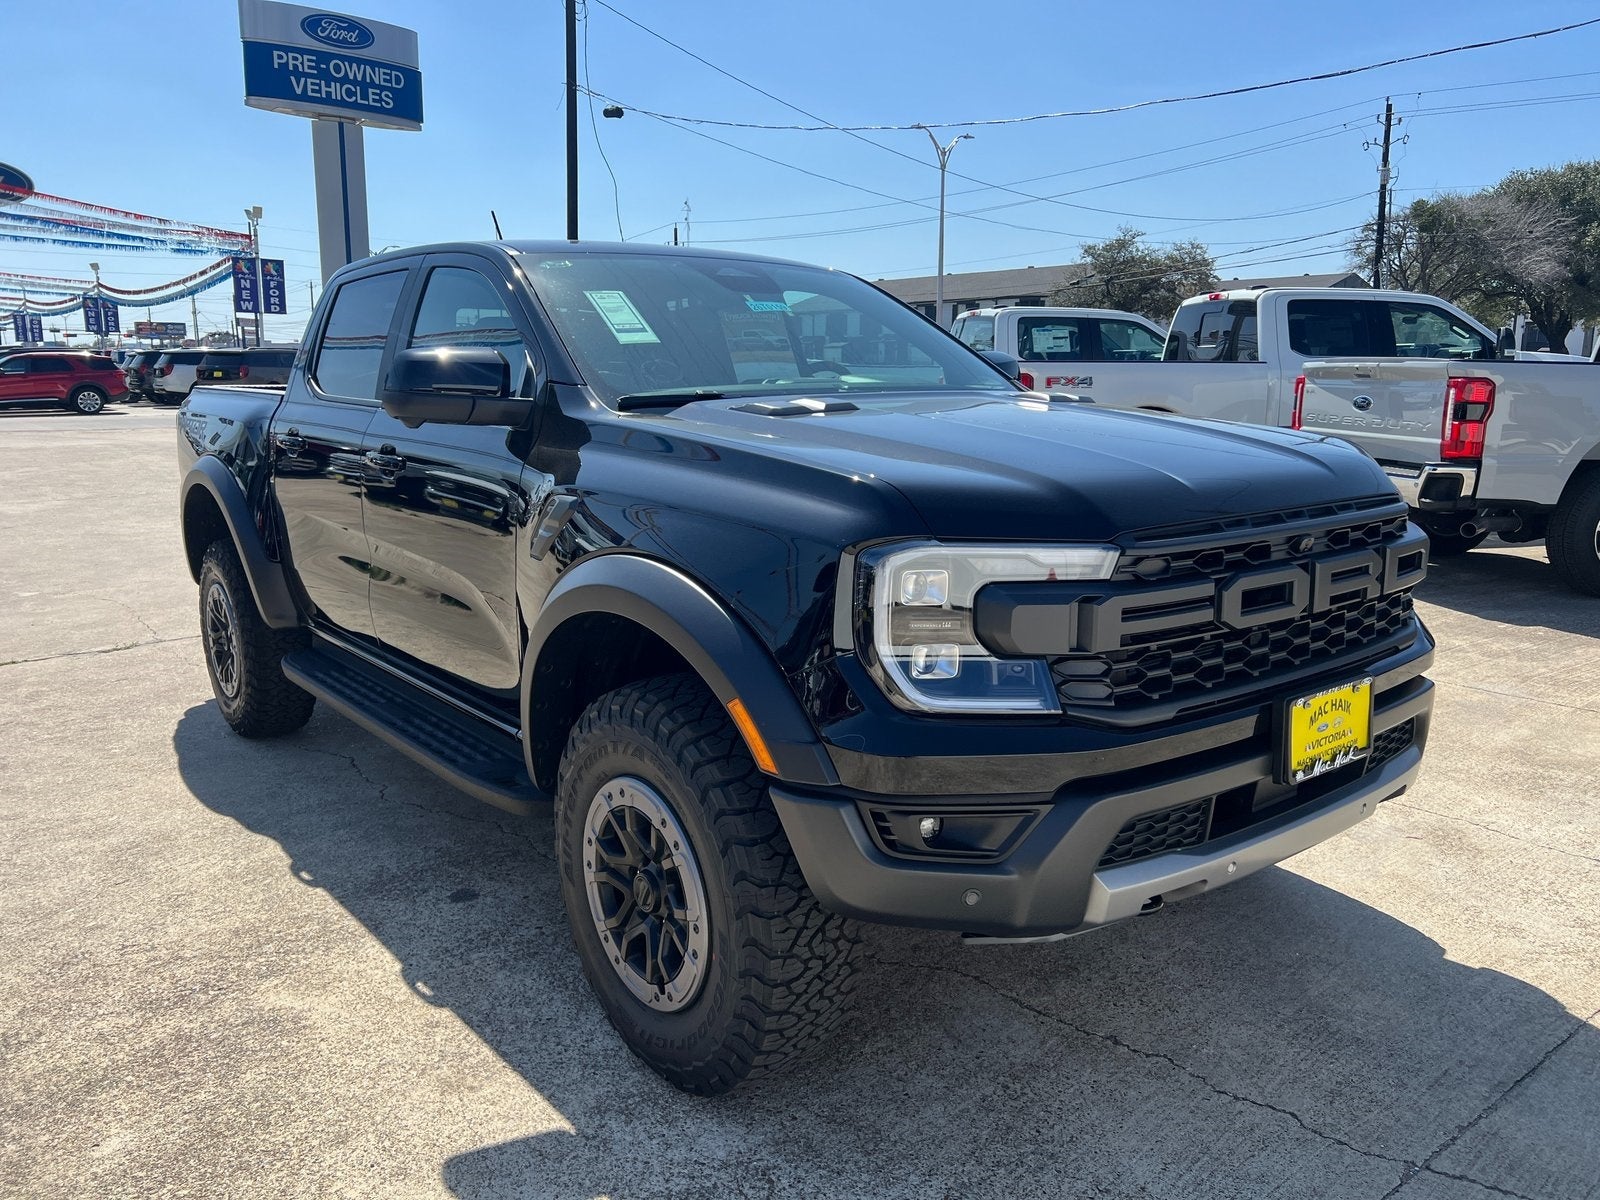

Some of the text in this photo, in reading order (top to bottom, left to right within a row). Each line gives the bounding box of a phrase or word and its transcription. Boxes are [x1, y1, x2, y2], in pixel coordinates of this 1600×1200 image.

[317, 18, 359, 43] Ford
[290, 75, 394, 109] VEHICLES
[240, 279, 254, 311] NEW
[269, 282, 280, 312] FORD
[87, 311, 98, 331] NEW
[107, 311, 116, 331] FORD
[1045, 376, 1093, 389] FX4
[1306, 412, 1432, 432] SUPER DUTY
[1093, 537, 1429, 654] FORD
[1309, 701, 1328, 730] MAC
[1331, 698, 1352, 715] HAIK
[1311, 729, 1346, 750] VICTORIA
